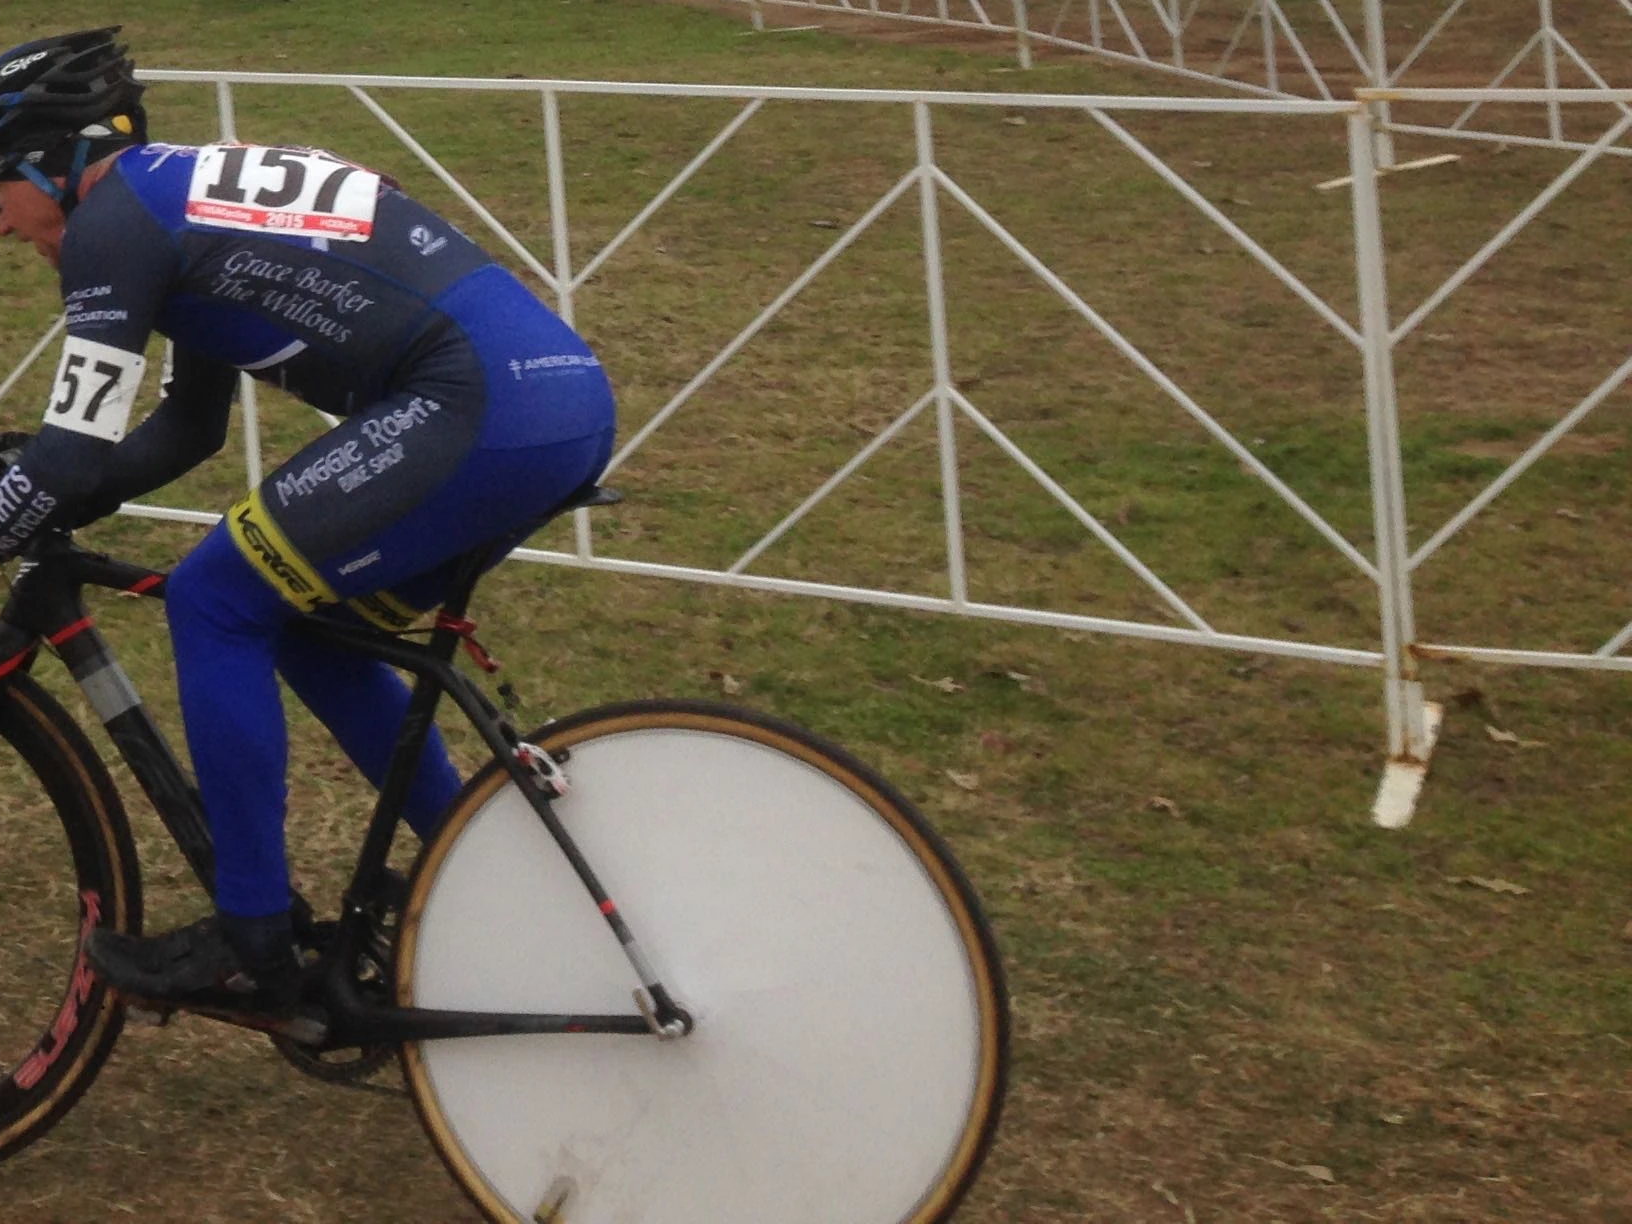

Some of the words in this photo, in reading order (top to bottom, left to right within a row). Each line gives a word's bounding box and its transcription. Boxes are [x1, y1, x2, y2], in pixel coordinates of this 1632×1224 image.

[206, 147, 358, 214] 157
[266, 212, 305, 228] 2015
[212, 273, 256, 302] The
[260, 288, 353, 343] Willows
[223, 250, 294, 282] Grace
[296, 267, 376, 314] Barker
[54, 353, 124, 423] 57
